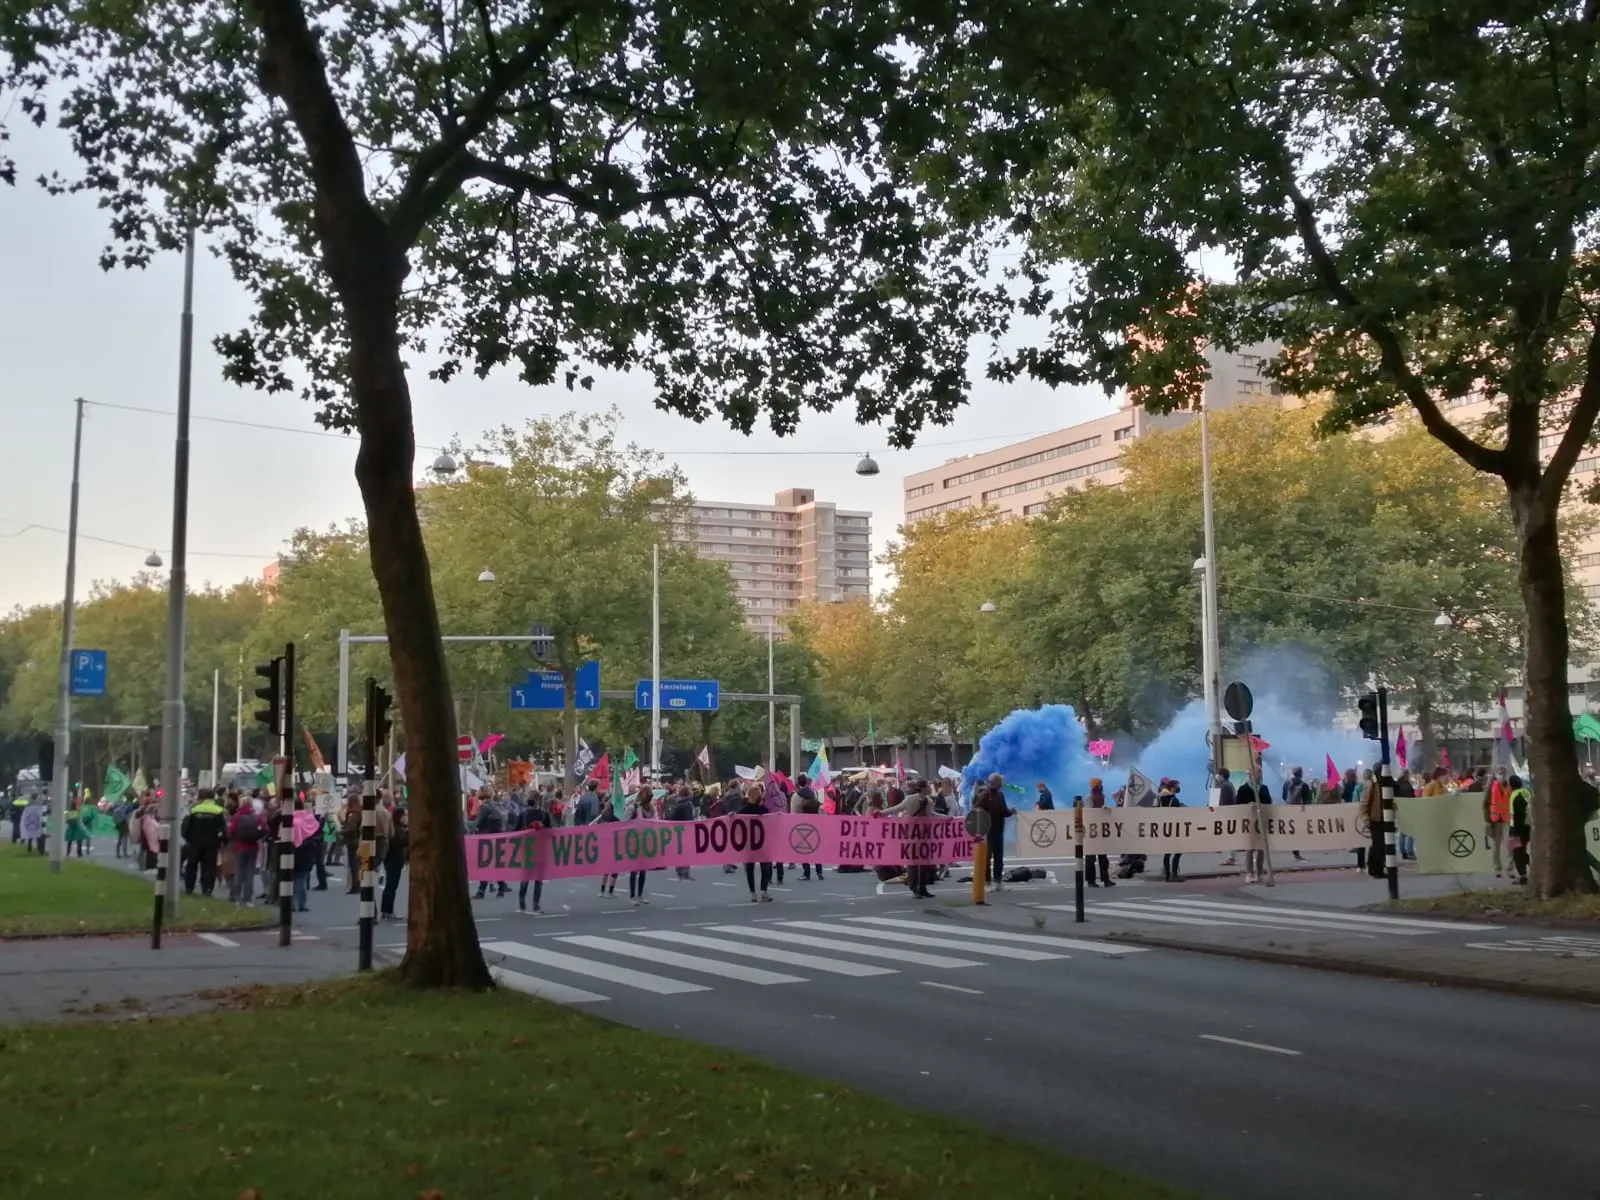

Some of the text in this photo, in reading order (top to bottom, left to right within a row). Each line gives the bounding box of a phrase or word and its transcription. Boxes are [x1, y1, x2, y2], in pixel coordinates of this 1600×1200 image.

[840, 820, 870, 837] DIT
[1306, 818, 1345, 834] ERIN
[478, 819, 765, 869] DEZE WEG LOOPT DOOD
[839, 841, 976, 860] HART KLOPT NIE
